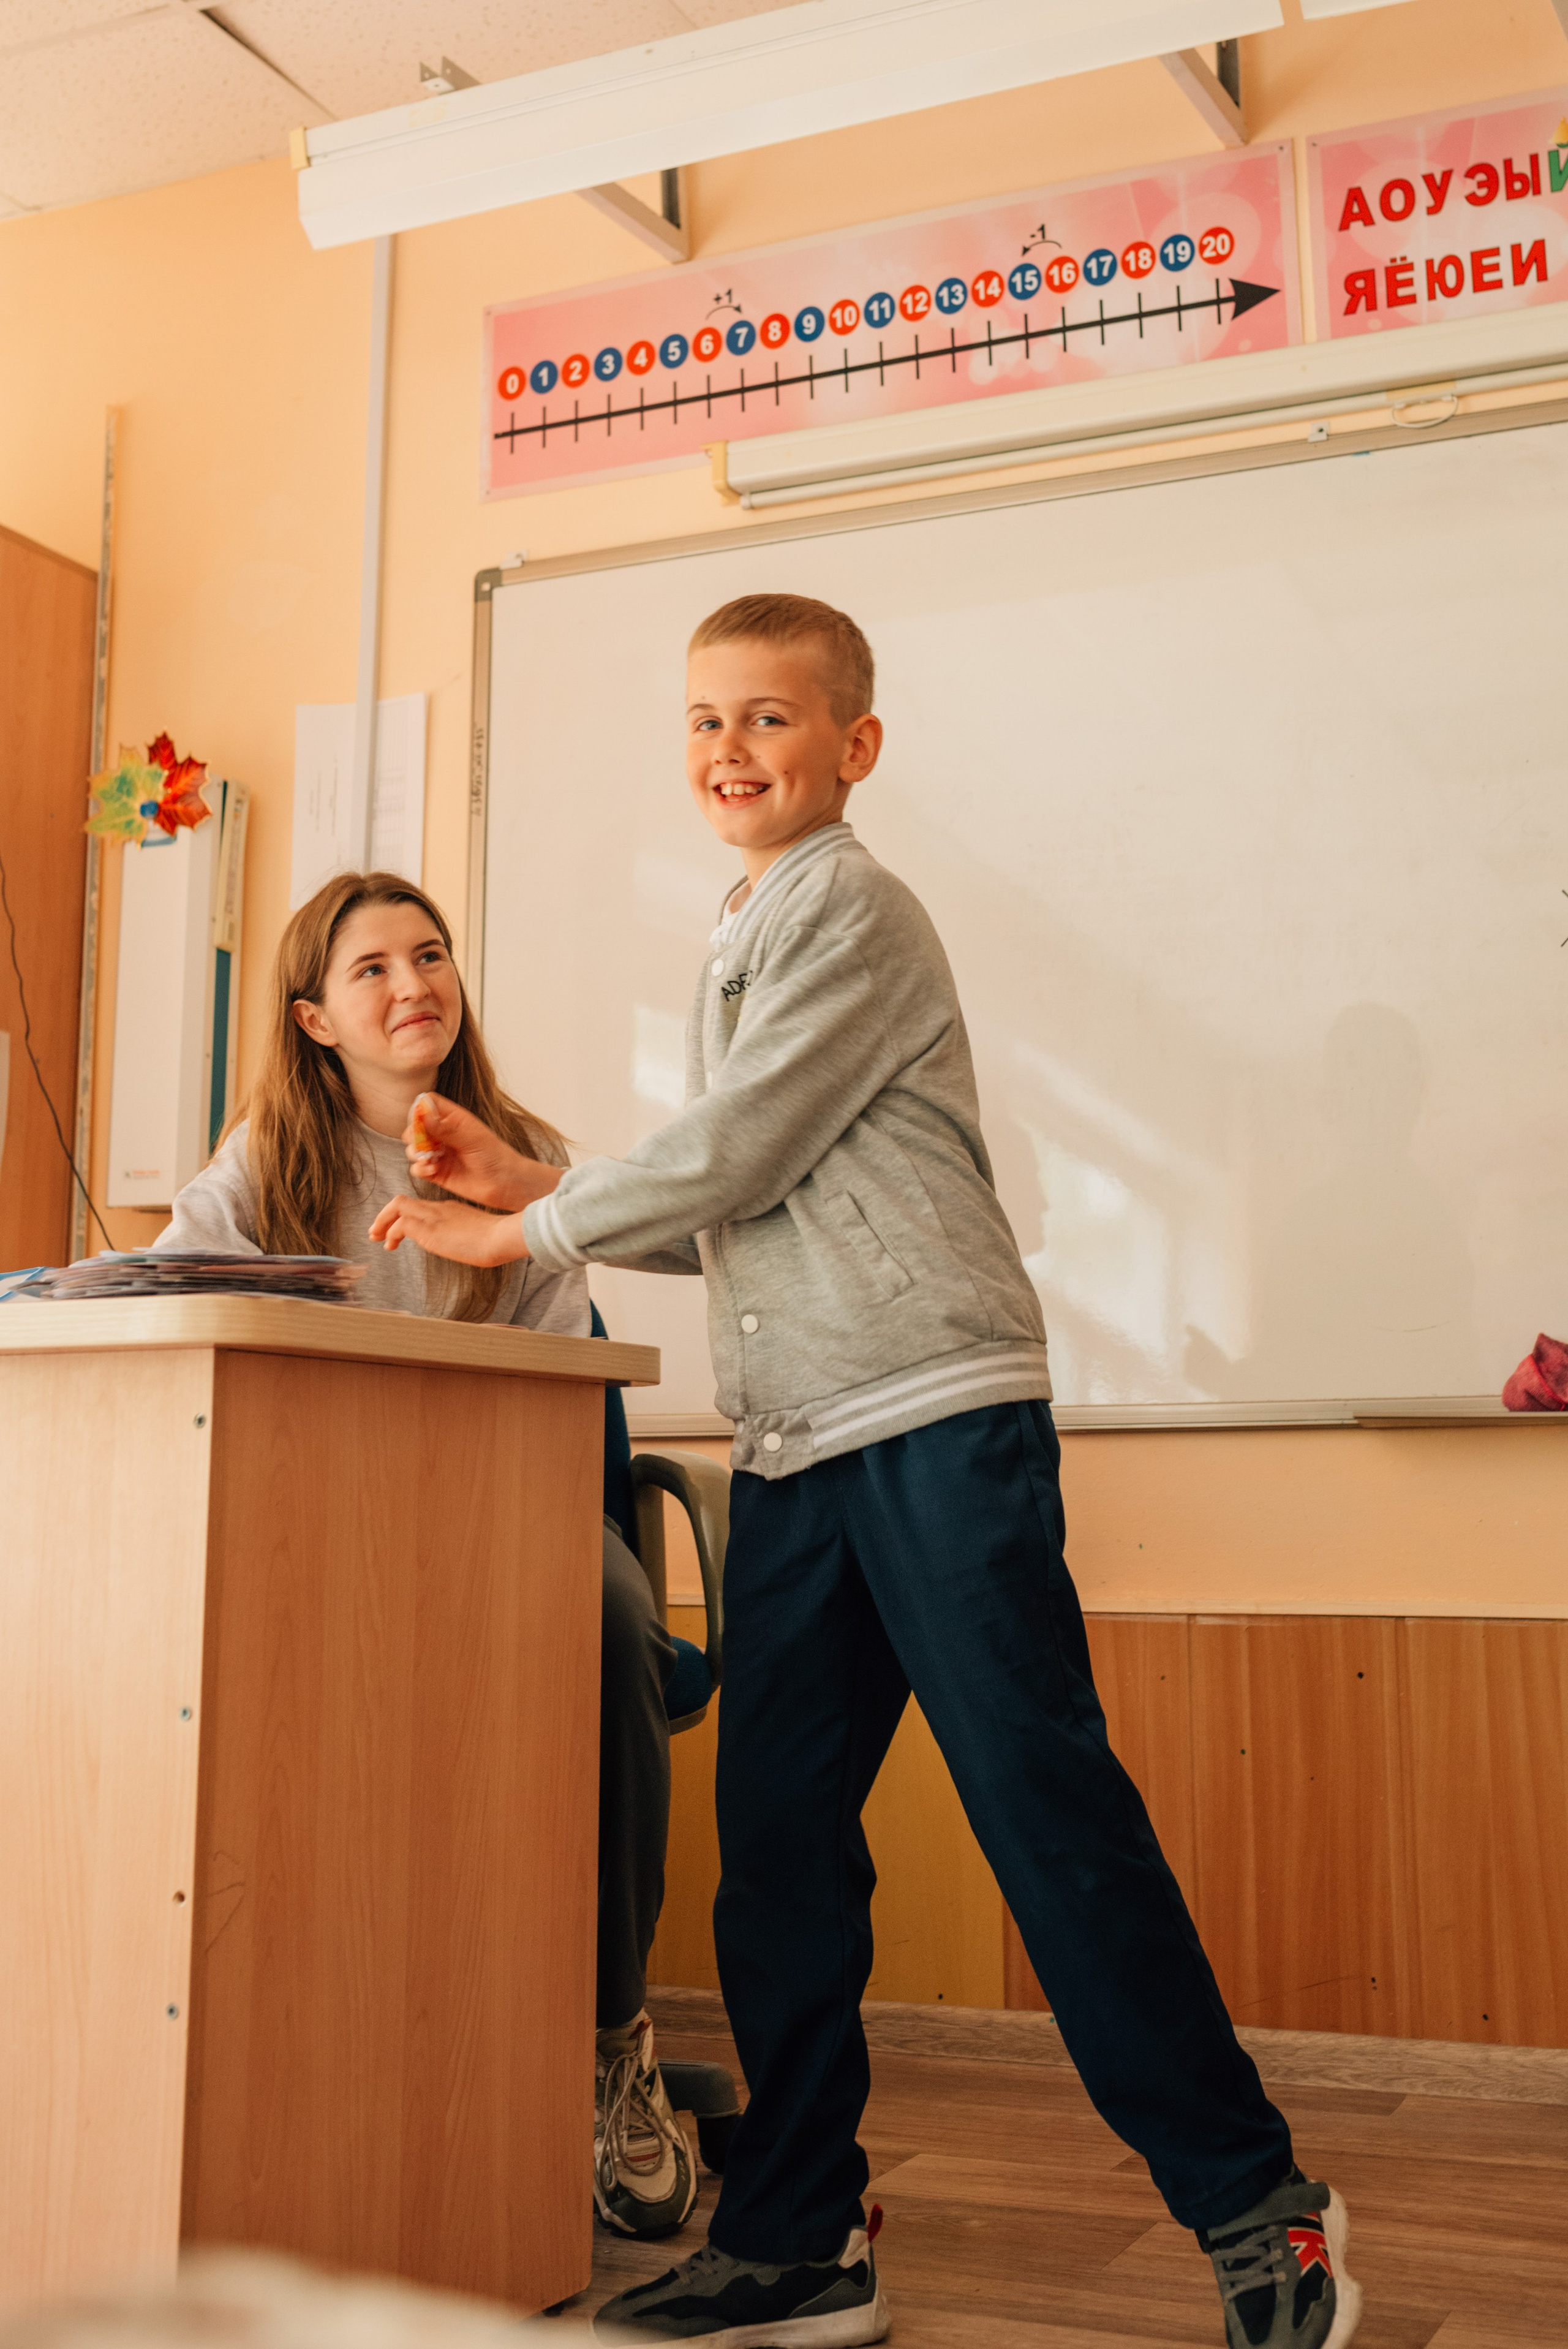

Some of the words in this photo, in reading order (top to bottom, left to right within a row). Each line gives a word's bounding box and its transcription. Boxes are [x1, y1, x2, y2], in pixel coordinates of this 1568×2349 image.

[1030, 223, 1047, 241] -1
[1343, 239, 1549, 316] ЯЁЮЕИ
[712, 288, 734, 304] +1
[507, 374, 519, 394] 0
[538, 366, 549, 387] 1
[570, 361, 582, 382] 2
[601, 354, 616, 377] 3
[634, 347, 649, 369] 4
[668, 340, 682, 362] 5
[701, 335, 714, 355] 6
[735, 327, 750, 349] 7
[769, 321, 782, 342] 8
[802, 314, 817, 335] 9
[832, 306, 858, 328] 10
[869, 298, 891, 322] 11
[903, 292, 929, 314] 12
[938, 284, 965, 308] 13
[974, 277, 1001, 301] 14
[1011, 270, 1039, 294] 15
[1049, 262, 1076, 286] 16
[1087, 255, 1114, 279] 17
[1125, 248, 1153, 272] 18
[1164, 241, 1192, 265] 19
[1202, 233, 1231, 258] 20
[721, 970, 752, 1002] ADF
